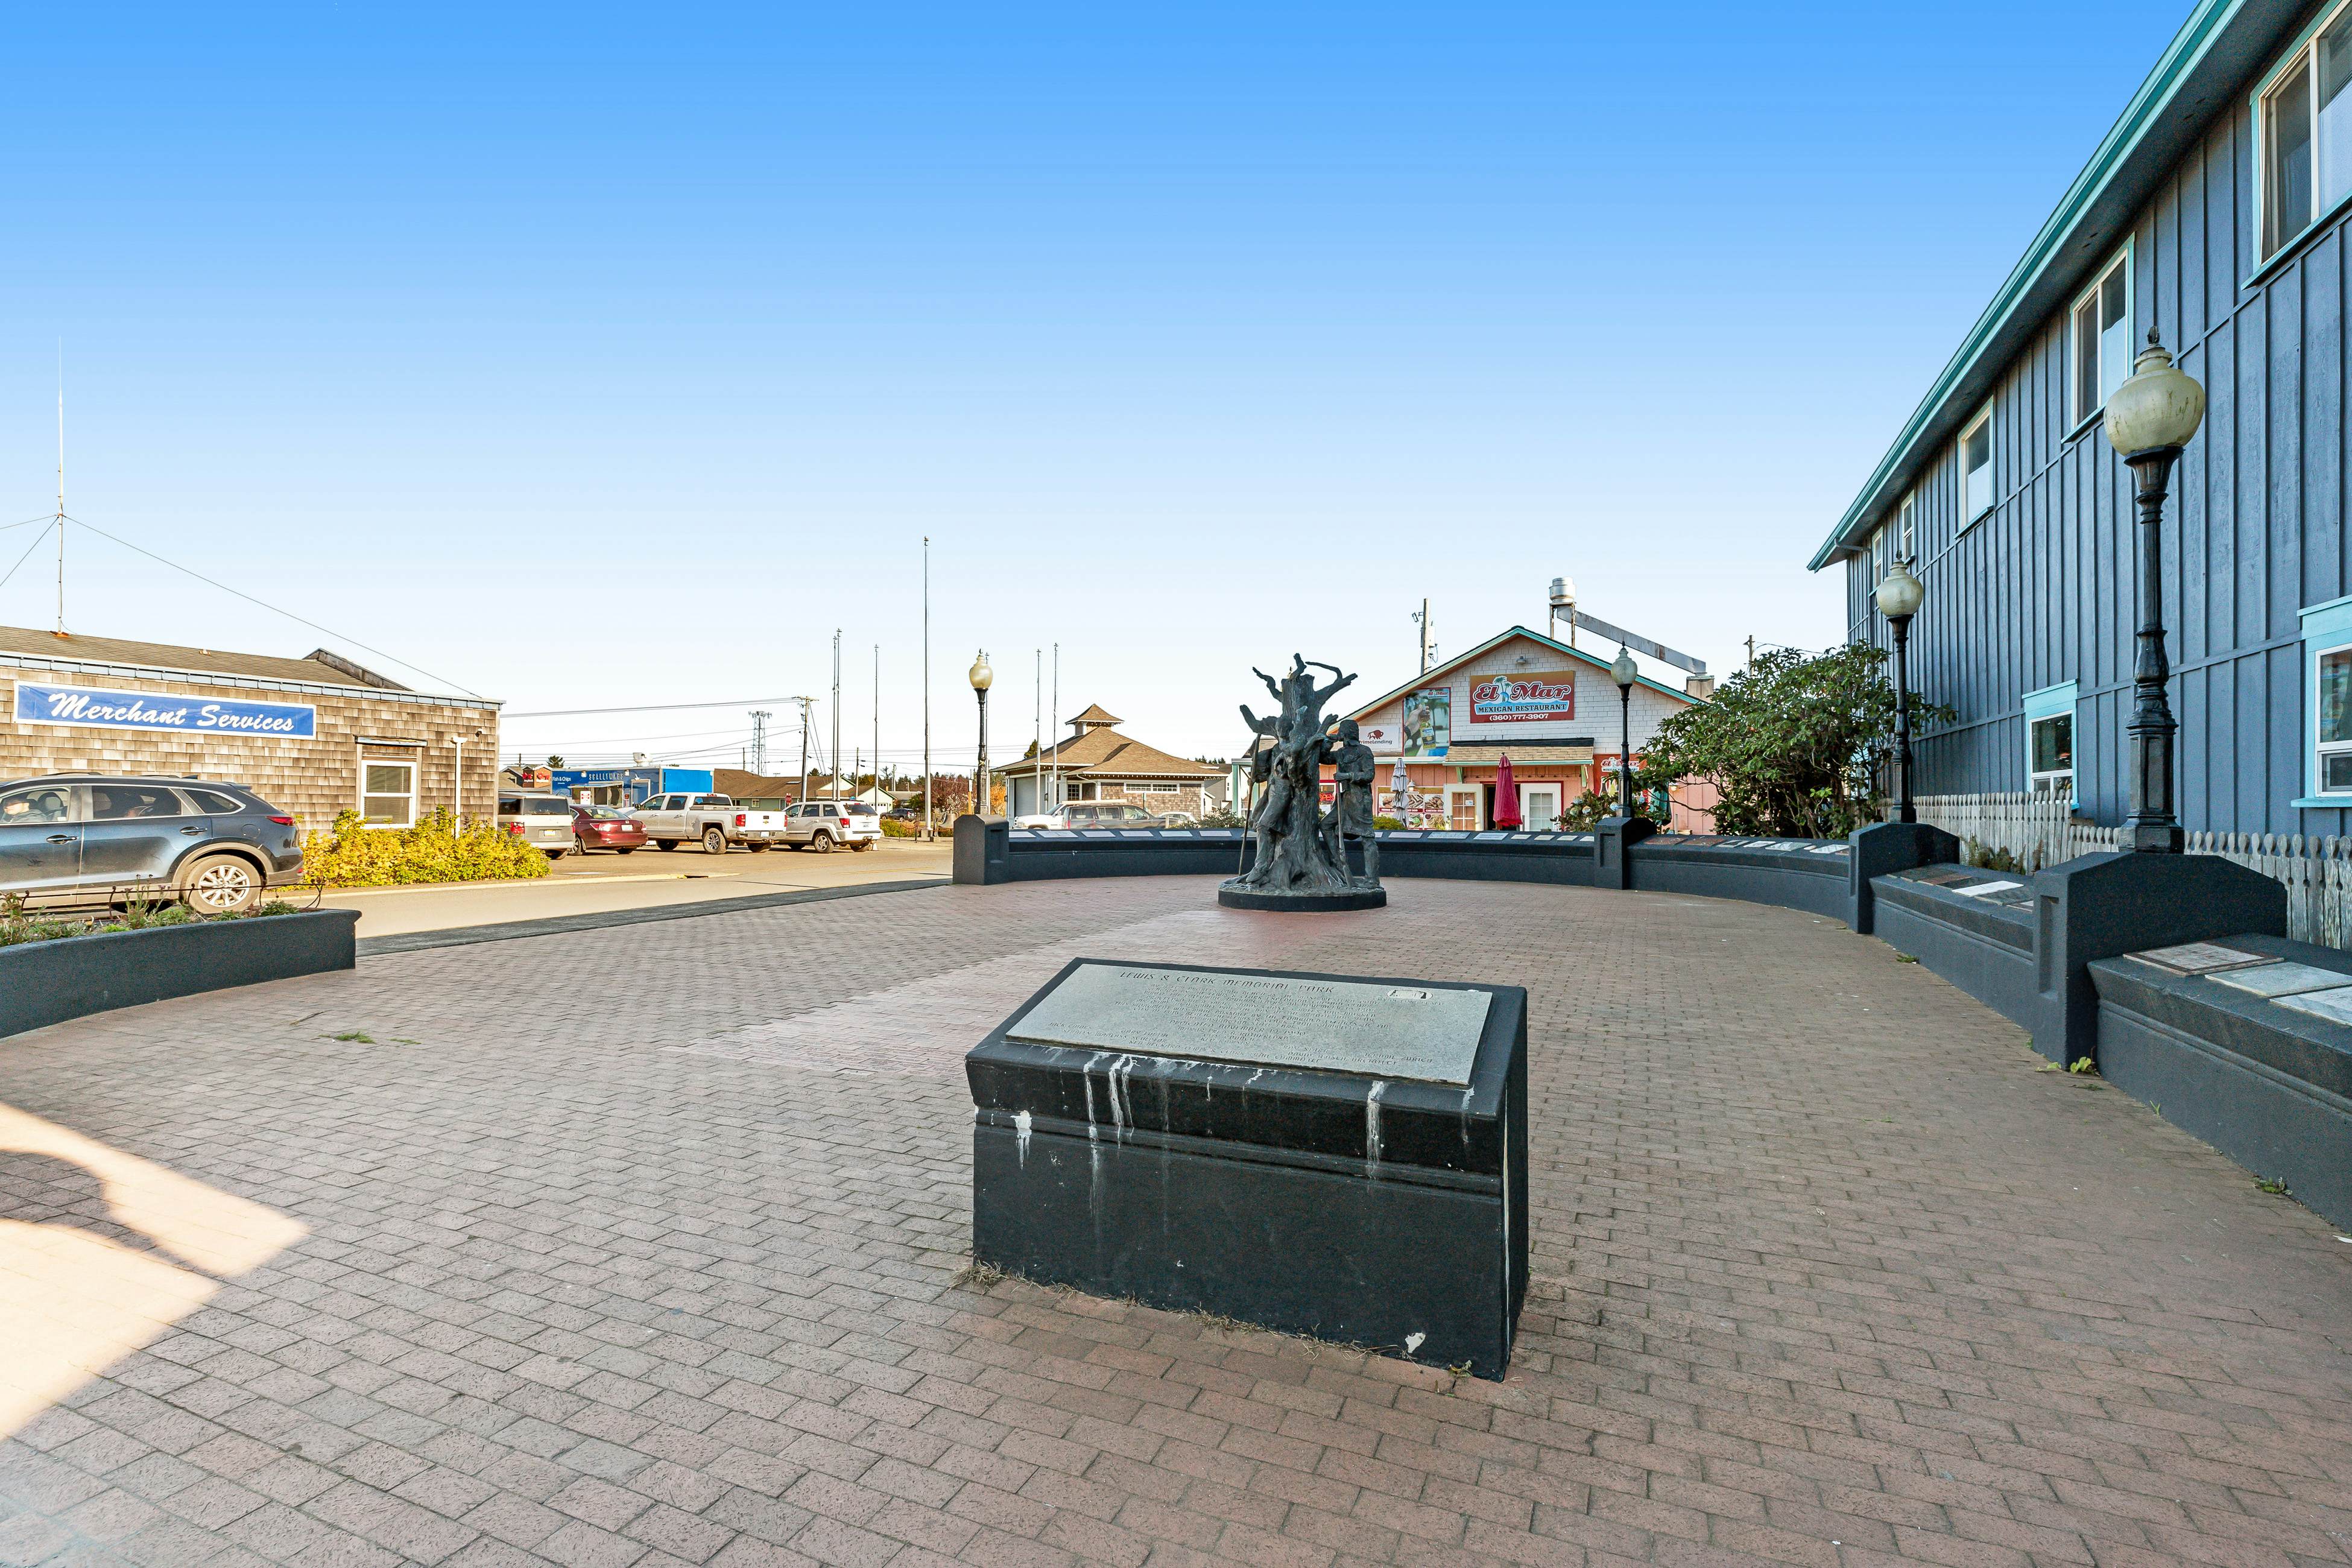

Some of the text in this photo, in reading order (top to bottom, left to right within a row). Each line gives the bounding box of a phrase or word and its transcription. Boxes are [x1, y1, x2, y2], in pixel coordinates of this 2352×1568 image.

[1474, 682, 1569, 701] El Mar
[48, 691, 294, 732] Merchant Services
[1515, 703, 1566, 712] RESTAURANT
[1120, 972, 1155, 980] LEWIS
[1177, 975, 1216, 984] CLARK
[1222, 979, 1290, 990] MEMORIAL
[1299, 985, 1335, 993] PARK
